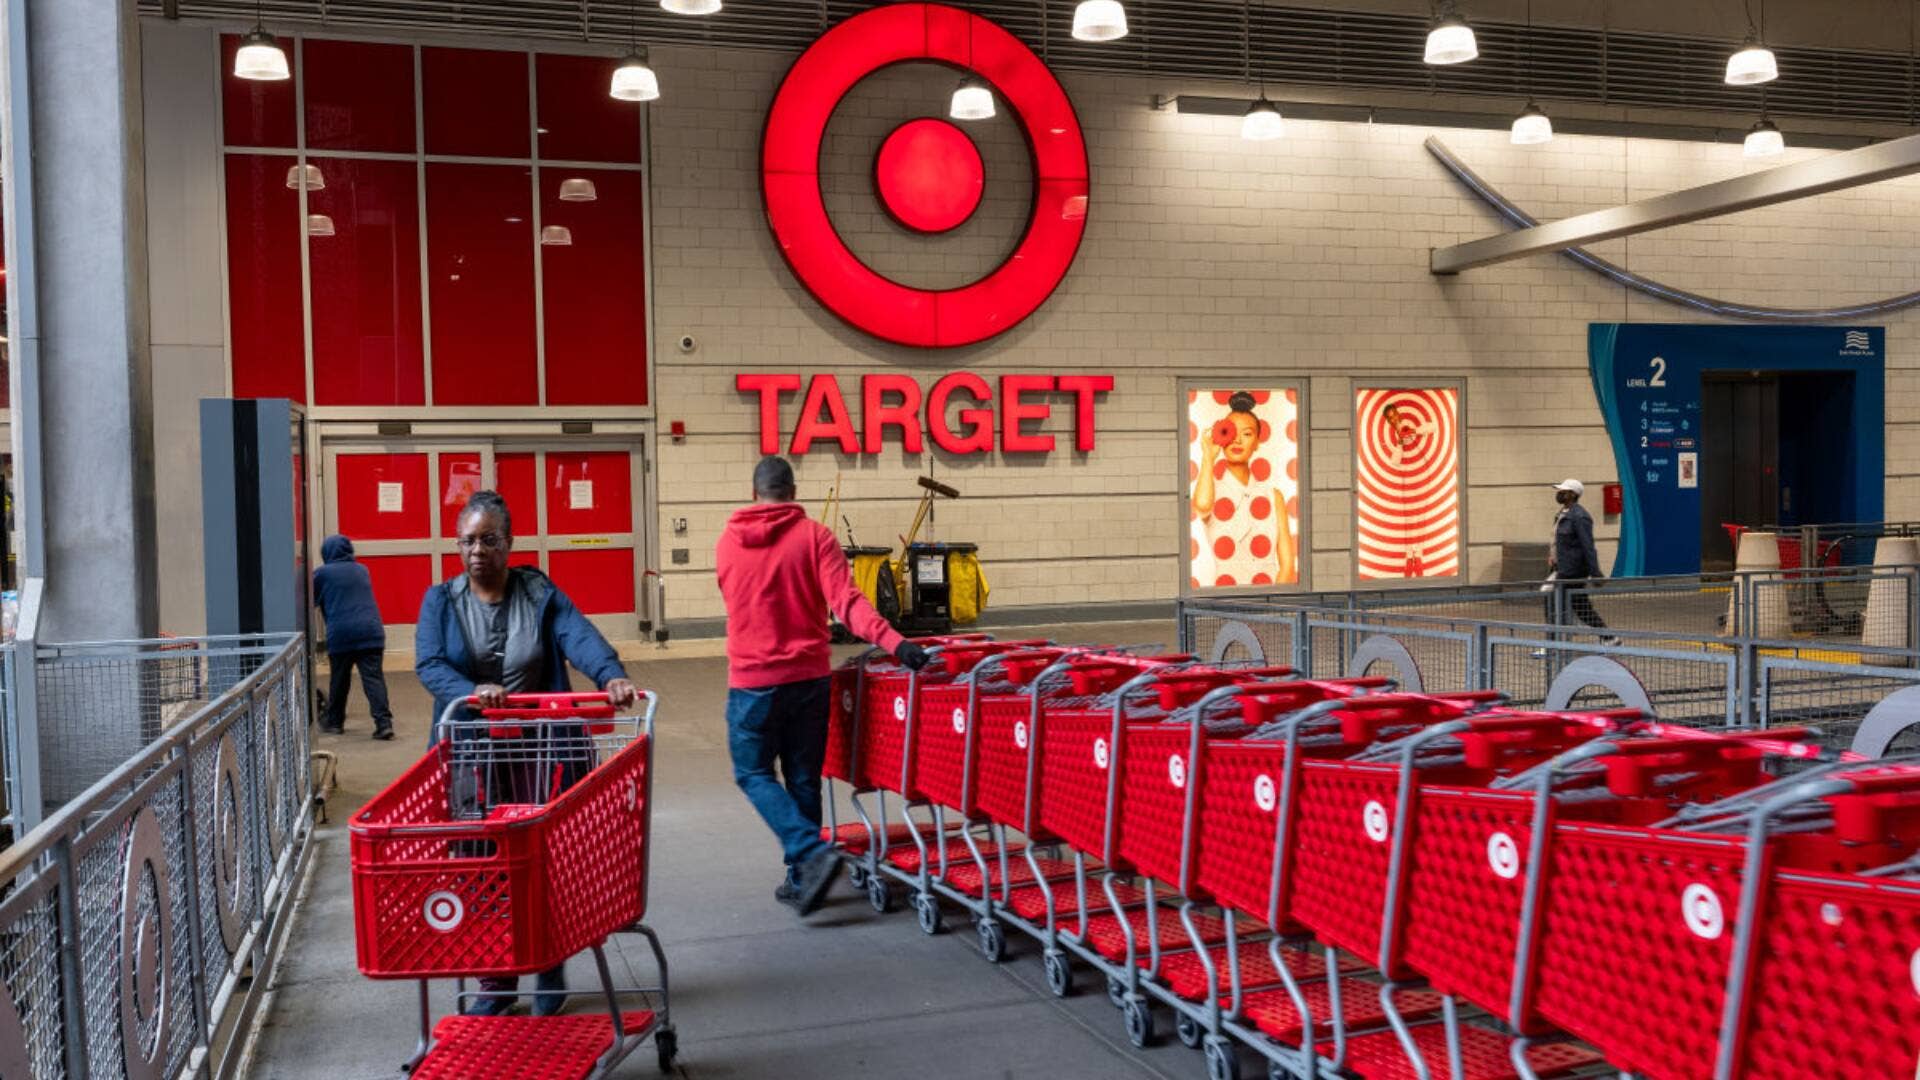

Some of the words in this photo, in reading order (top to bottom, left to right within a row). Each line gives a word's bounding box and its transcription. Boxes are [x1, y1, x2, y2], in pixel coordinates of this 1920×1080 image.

[1626, 378, 1646, 387] LEVEL
[1649, 356, 1666, 387] 2
[1641, 400, 1648, 412] 4
[735, 371, 1115, 455] TARGET
[1641, 418, 1648, 430] 3
[1641, 436, 1648, 448] 2
